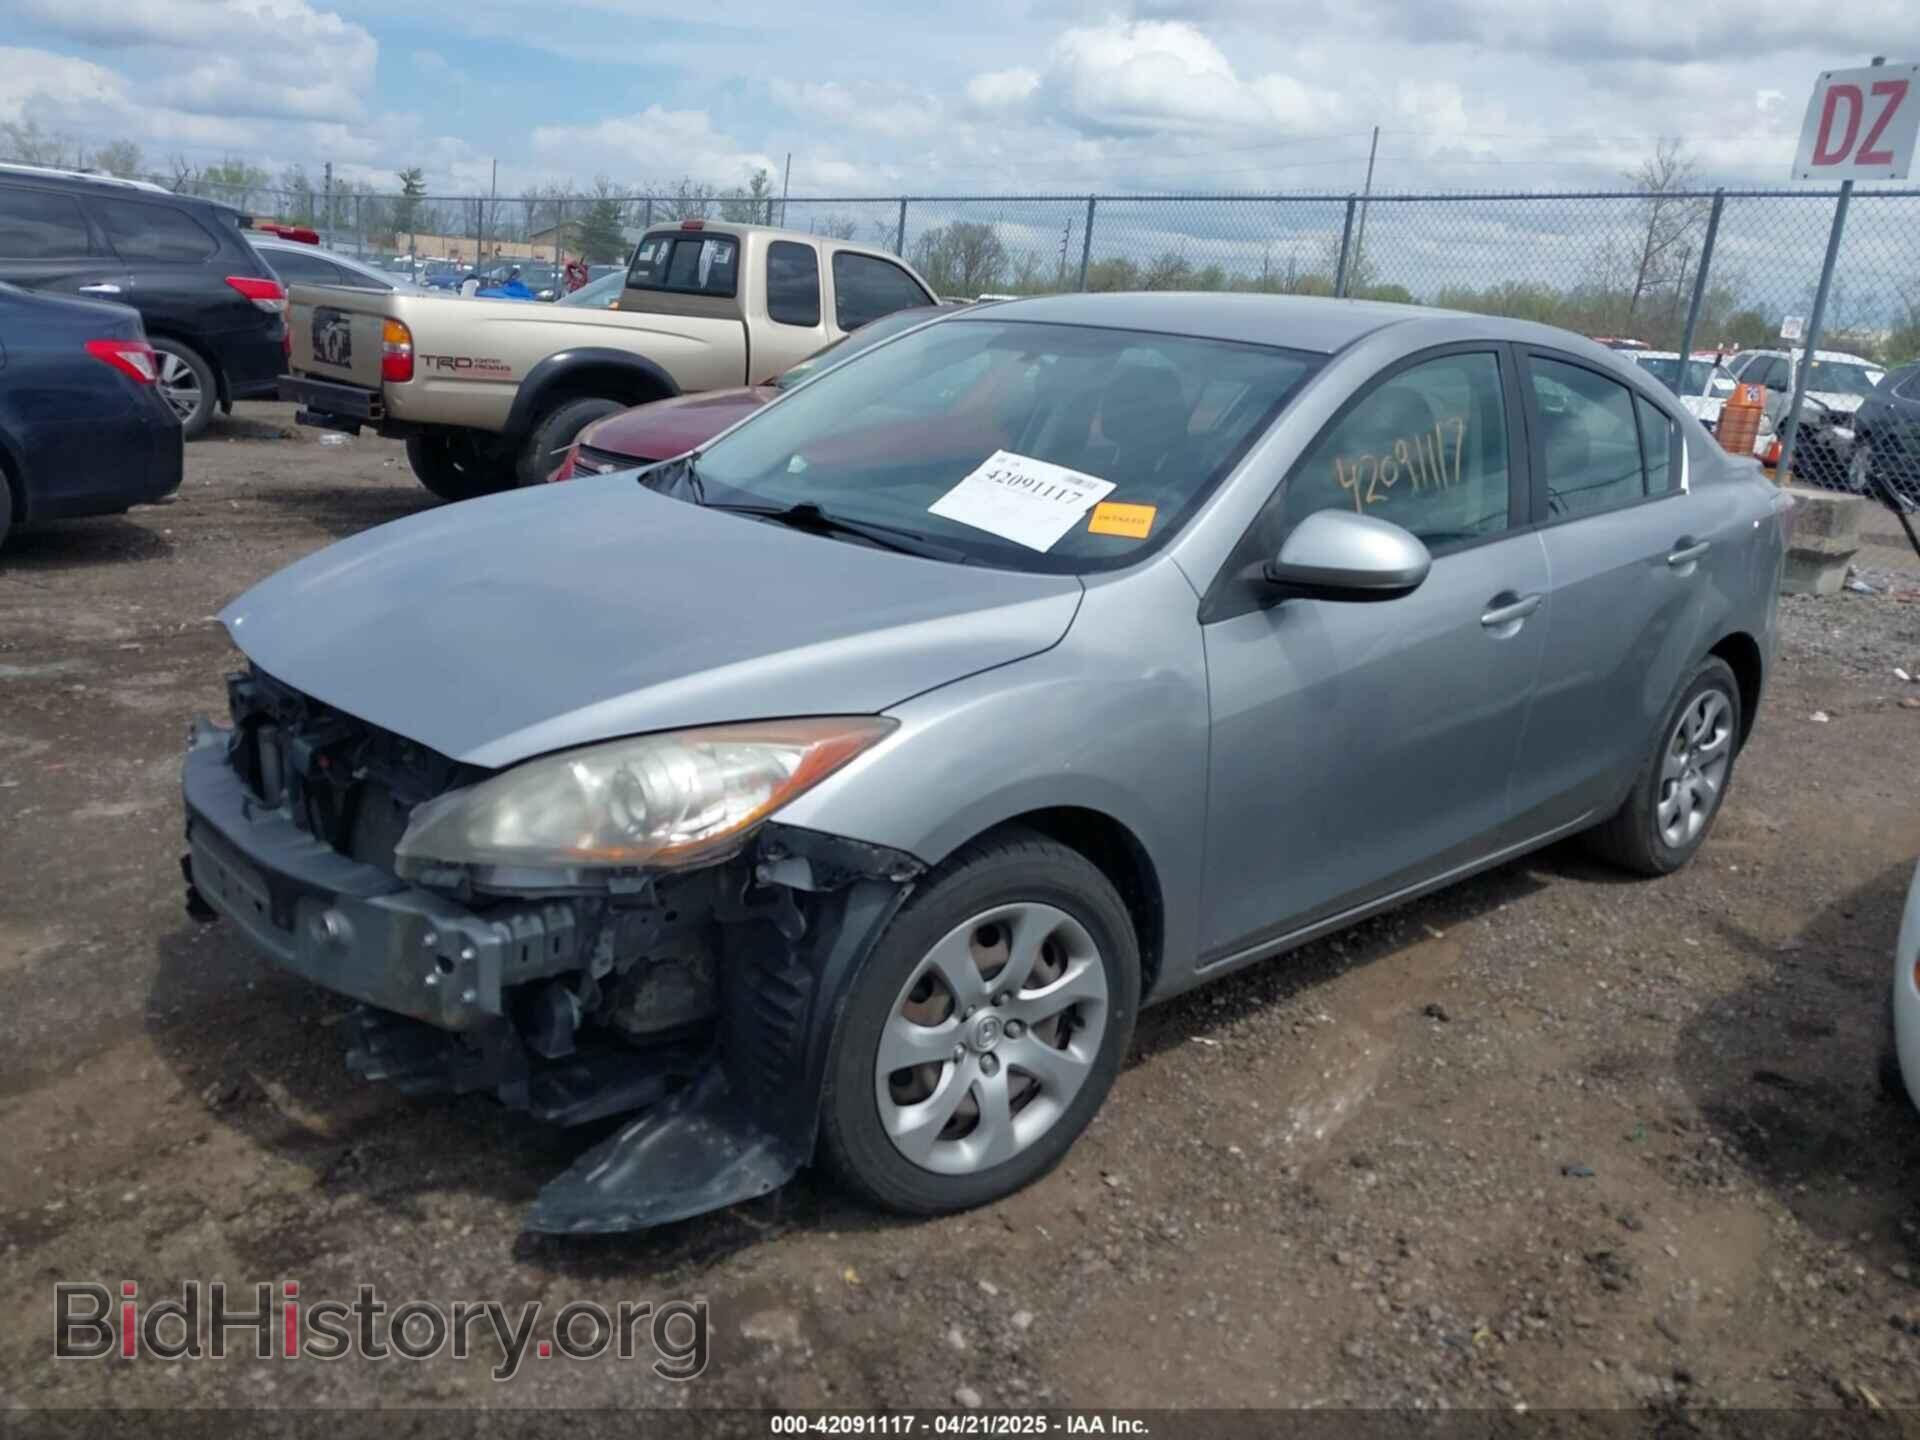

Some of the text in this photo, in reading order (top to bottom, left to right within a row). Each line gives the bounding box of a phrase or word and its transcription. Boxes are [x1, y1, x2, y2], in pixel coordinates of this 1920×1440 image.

[1811, 80, 1909, 165] DZ
[419, 354, 473, 371] TRD
[986, 469, 1084, 505] 42091117
[1336, 415, 1466, 514] 42091117
